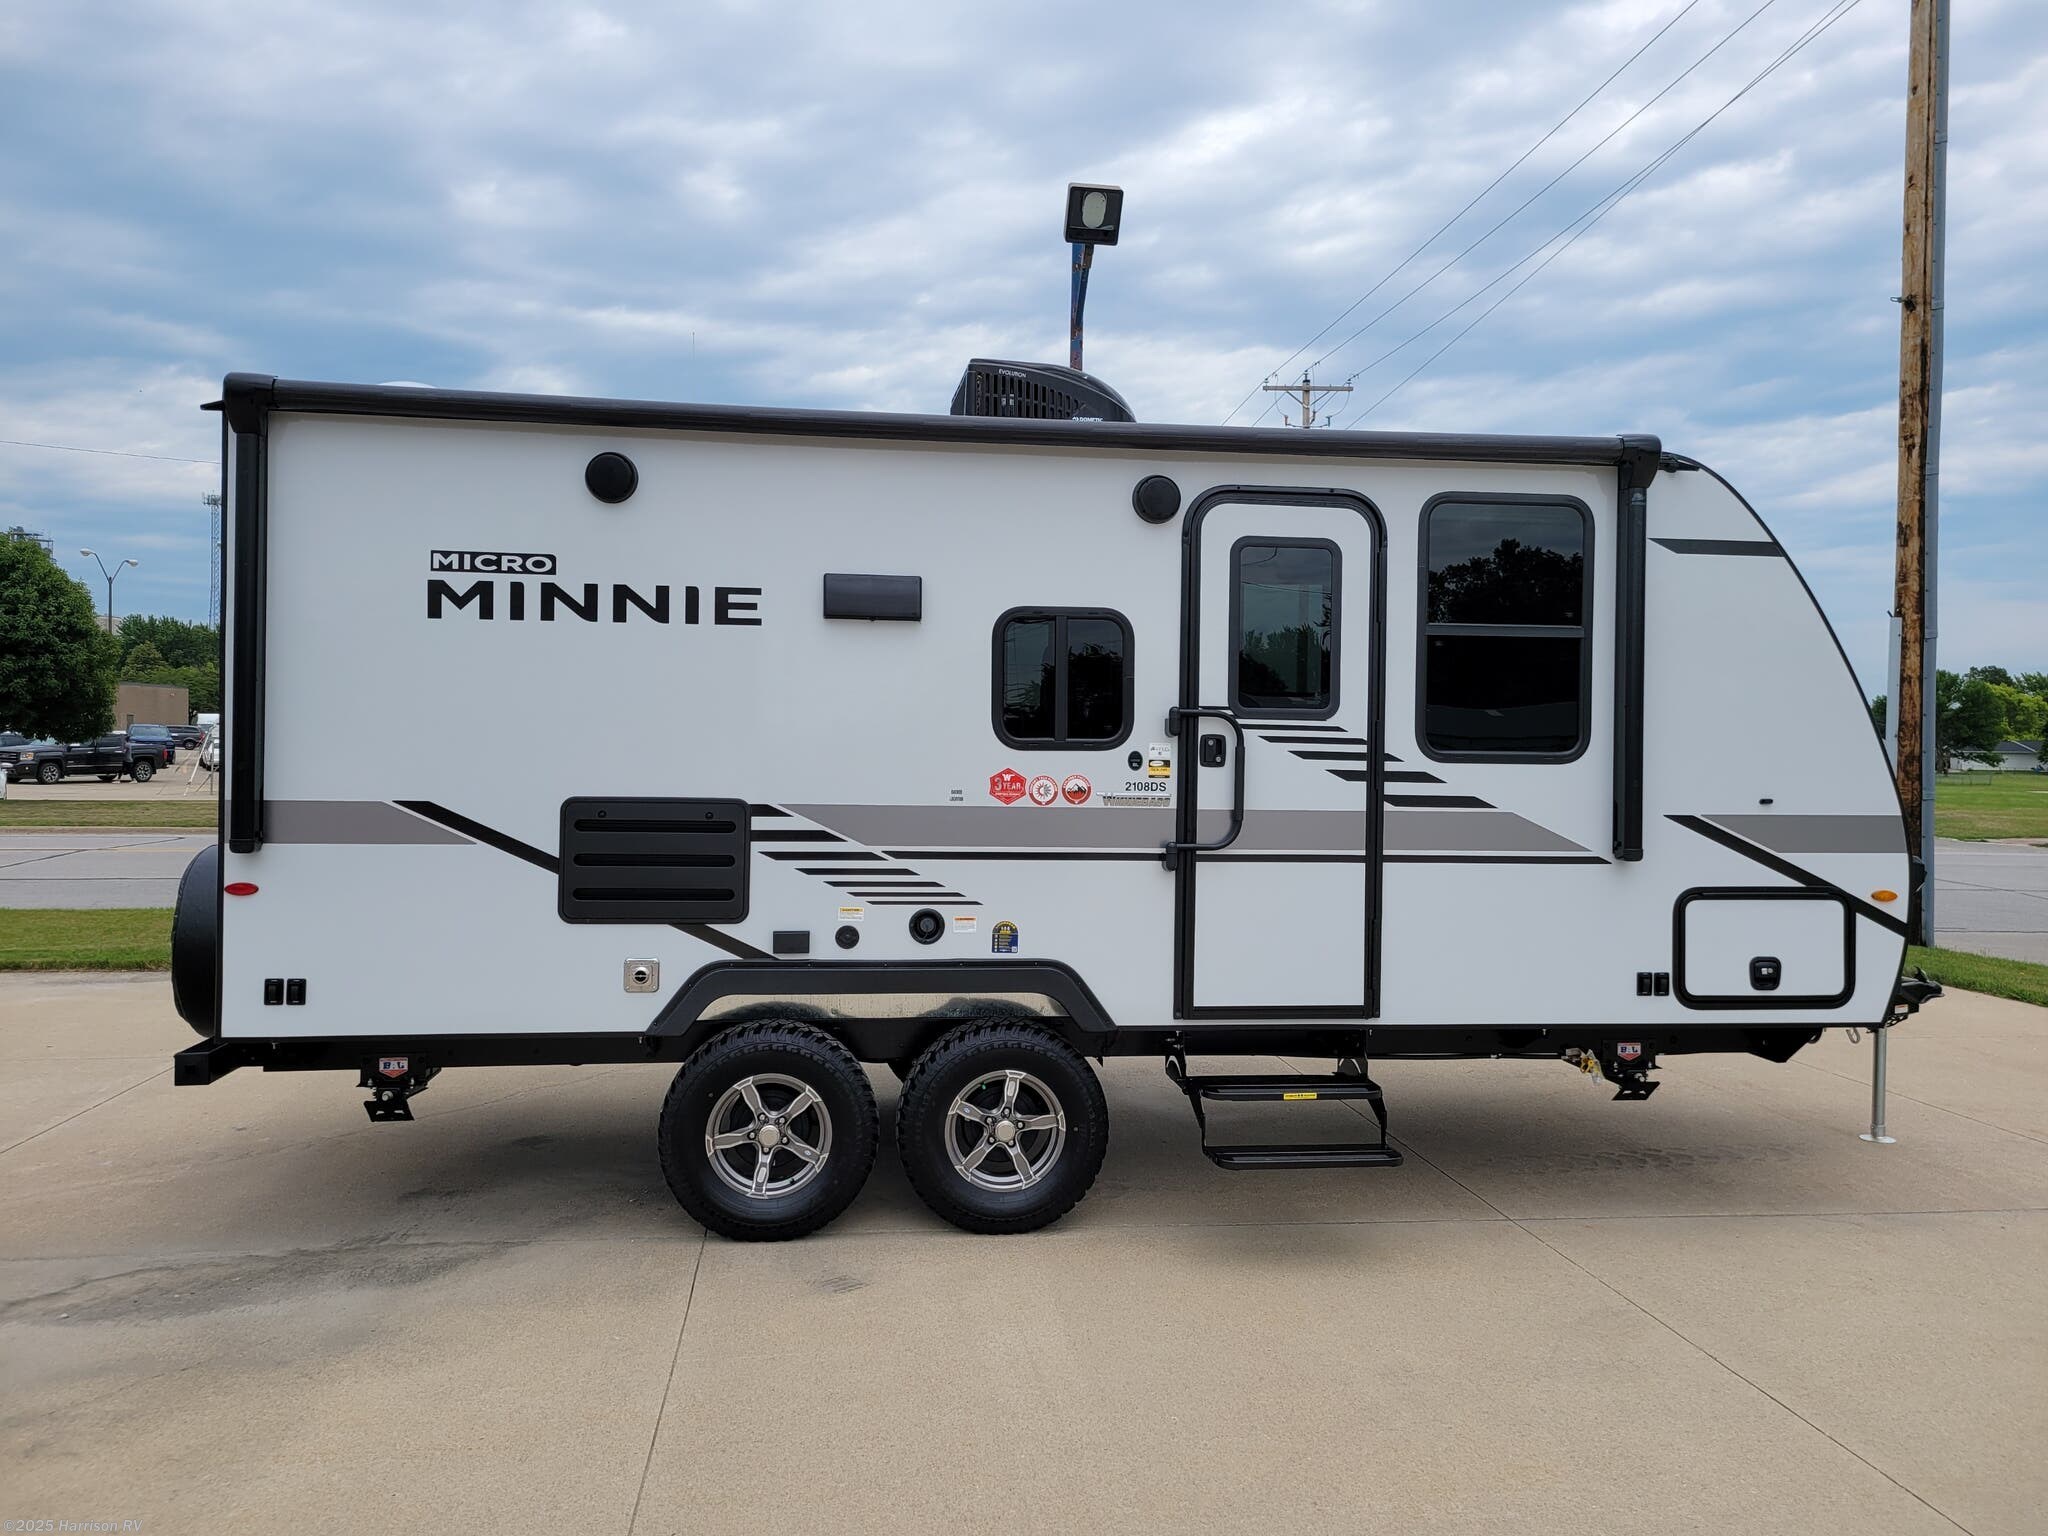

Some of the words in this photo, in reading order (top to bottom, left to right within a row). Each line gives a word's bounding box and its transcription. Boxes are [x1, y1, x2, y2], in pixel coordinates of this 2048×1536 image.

[998, 368, 1027, 378] EVOLUTION
[432, 552, 553, 573] MICRO
[427, 579, 763, 626] MINNIE
[994, 777, 1002, 791] 3
[1003, 782, 1021, 791] YEAR
[1125, 782, 1167, 792] 2108DS
